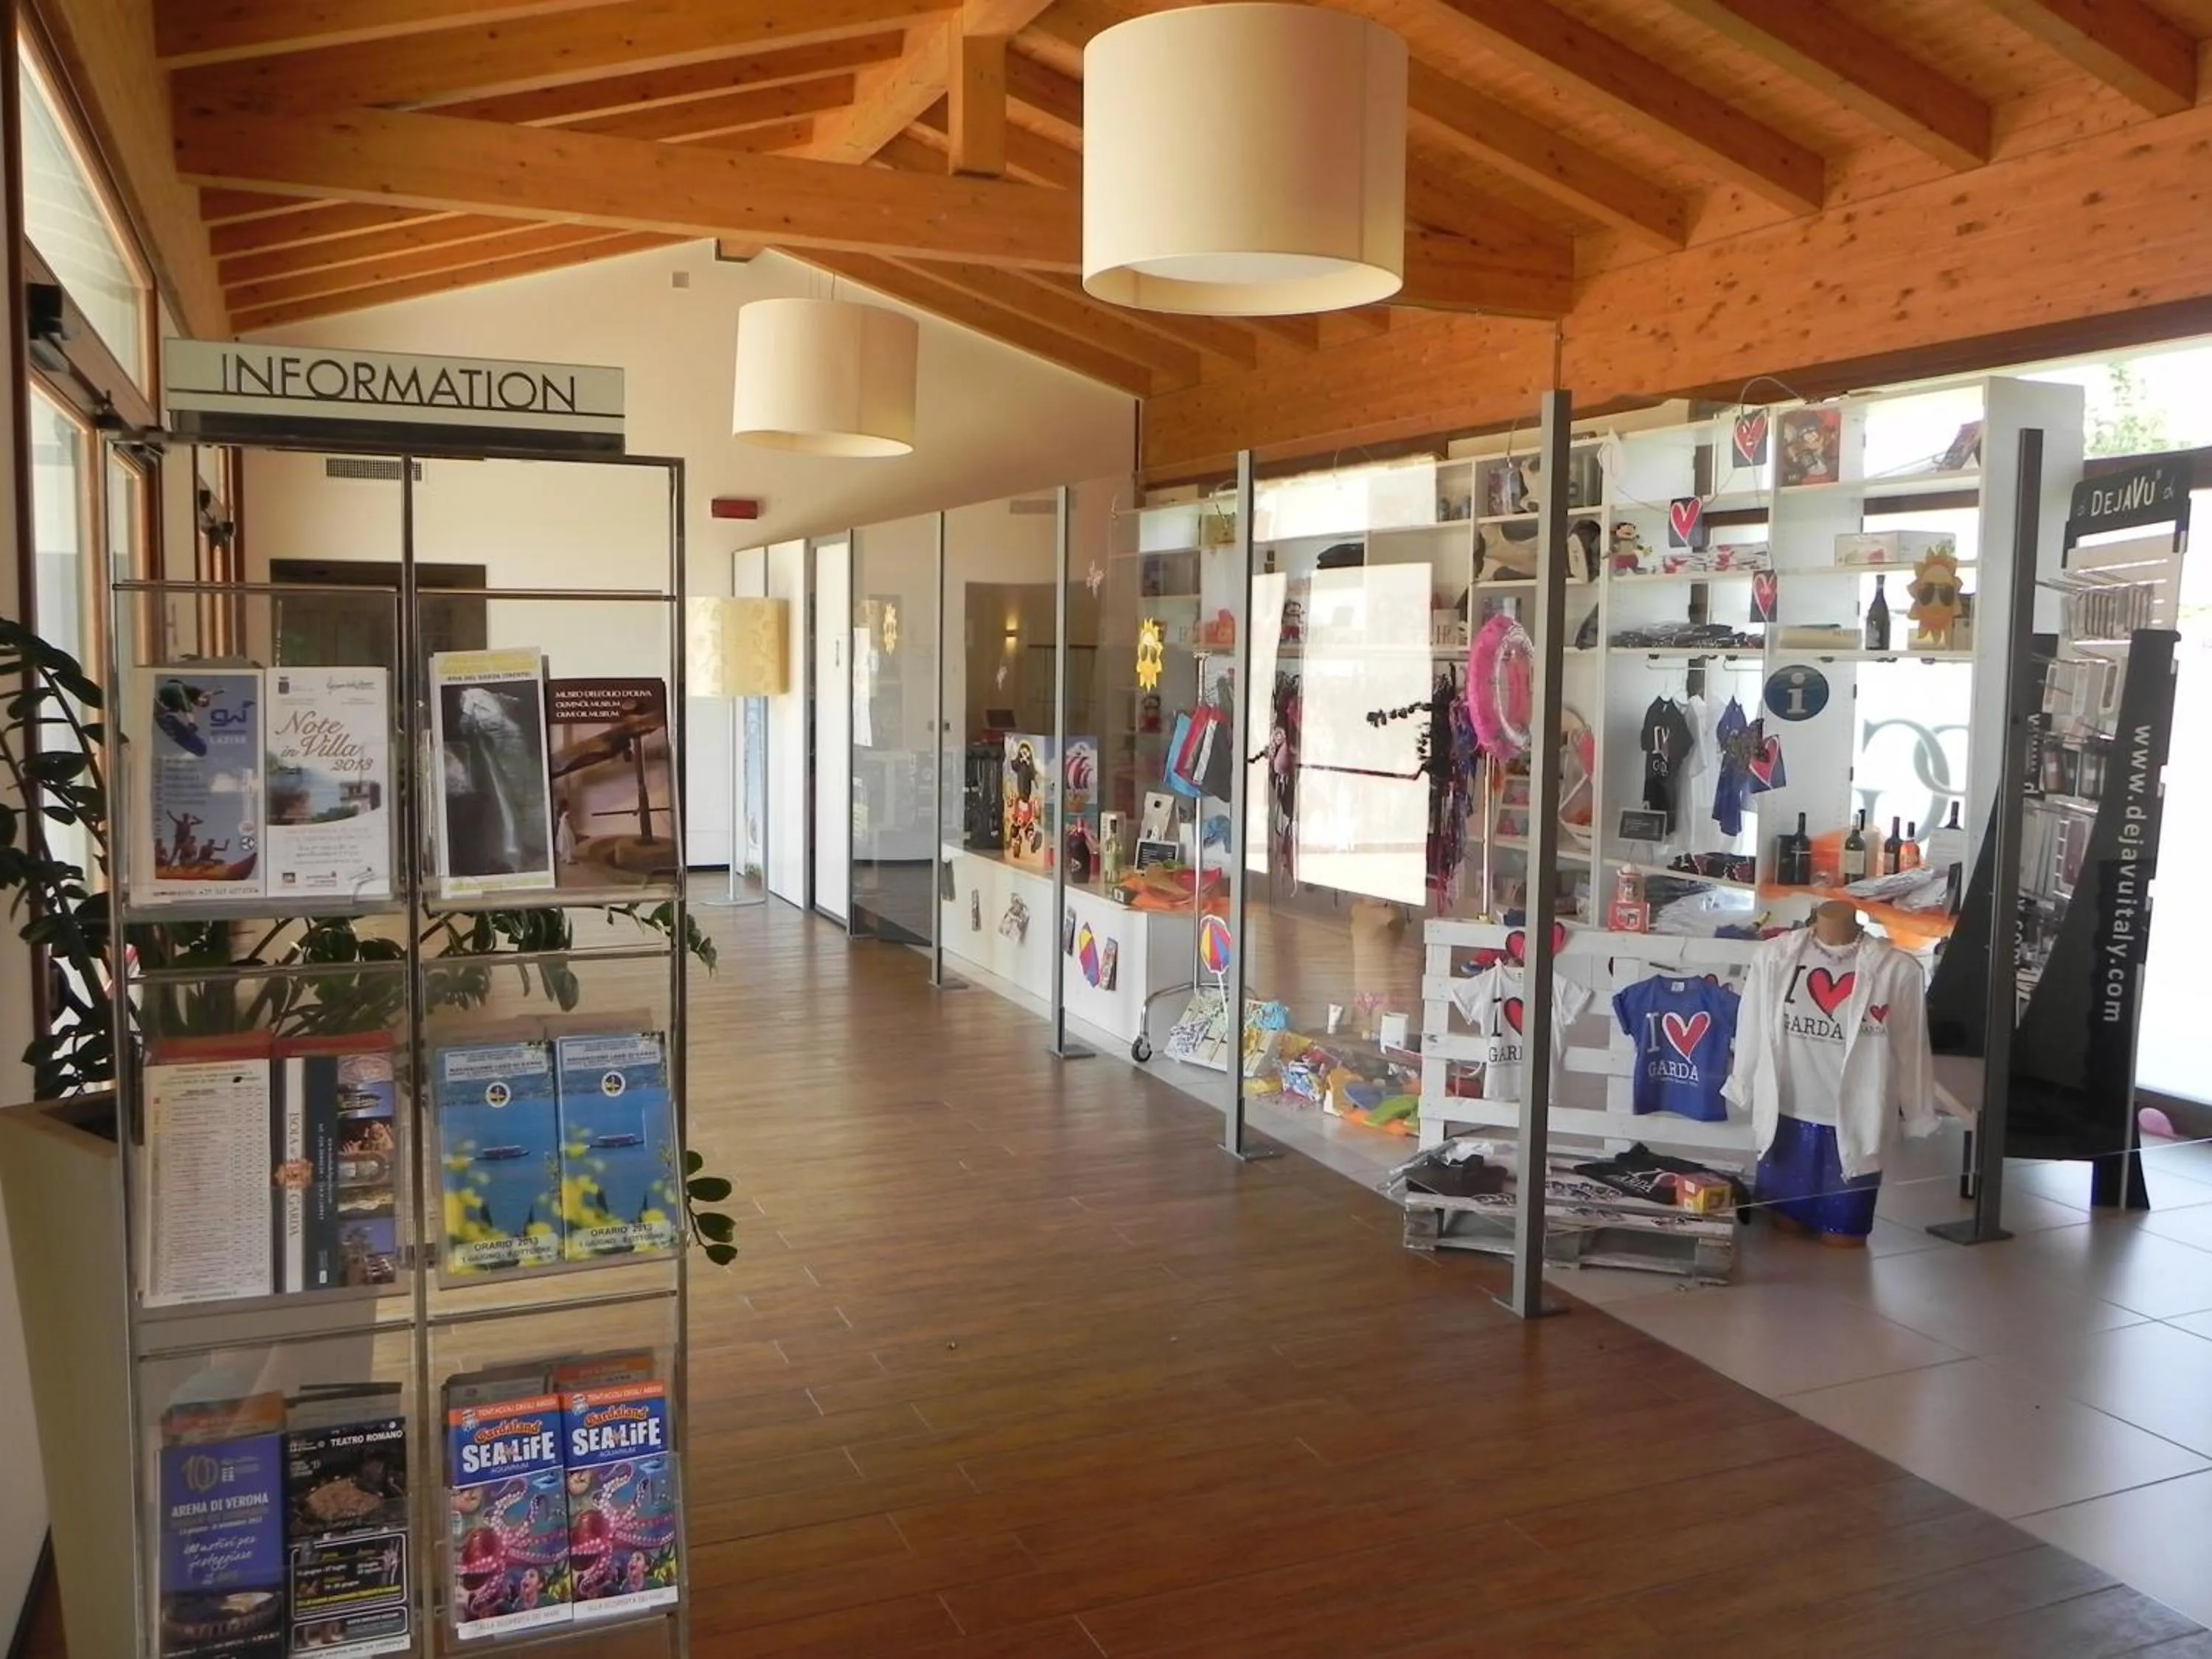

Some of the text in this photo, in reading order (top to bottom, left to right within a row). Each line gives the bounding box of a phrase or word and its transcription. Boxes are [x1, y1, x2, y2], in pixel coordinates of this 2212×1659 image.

[220, 353, 576, 413] INFORMATION
[274, 710, 344, 735] Note
[282, 733, 366, 757] in Villa
[2103, 725, 2152, 1023] www.dejavuitaly.com
[1645, 1012, 1660, 1053] I
[1489, 1045, 1523, 1062] GAR
[1648, 1060, 1700, 1082] GARDA
[591, 1226, 627, 1237] ORARIO
[474, 1240, 513, 1251] ORARIO
[584, 1404, 649, 1427] Gardaland
[330, 1435, 364, 1447] TEATRO
[366, 1430, 403, 1442] ROMANO
[473, 1419, 543, 1445] Gardaland
[572, 1425, 615, 1456] SEA
[462, 1441, 507, 1473] SEA
[171, 1492, 269, 1518] ARENA DI VERONA
